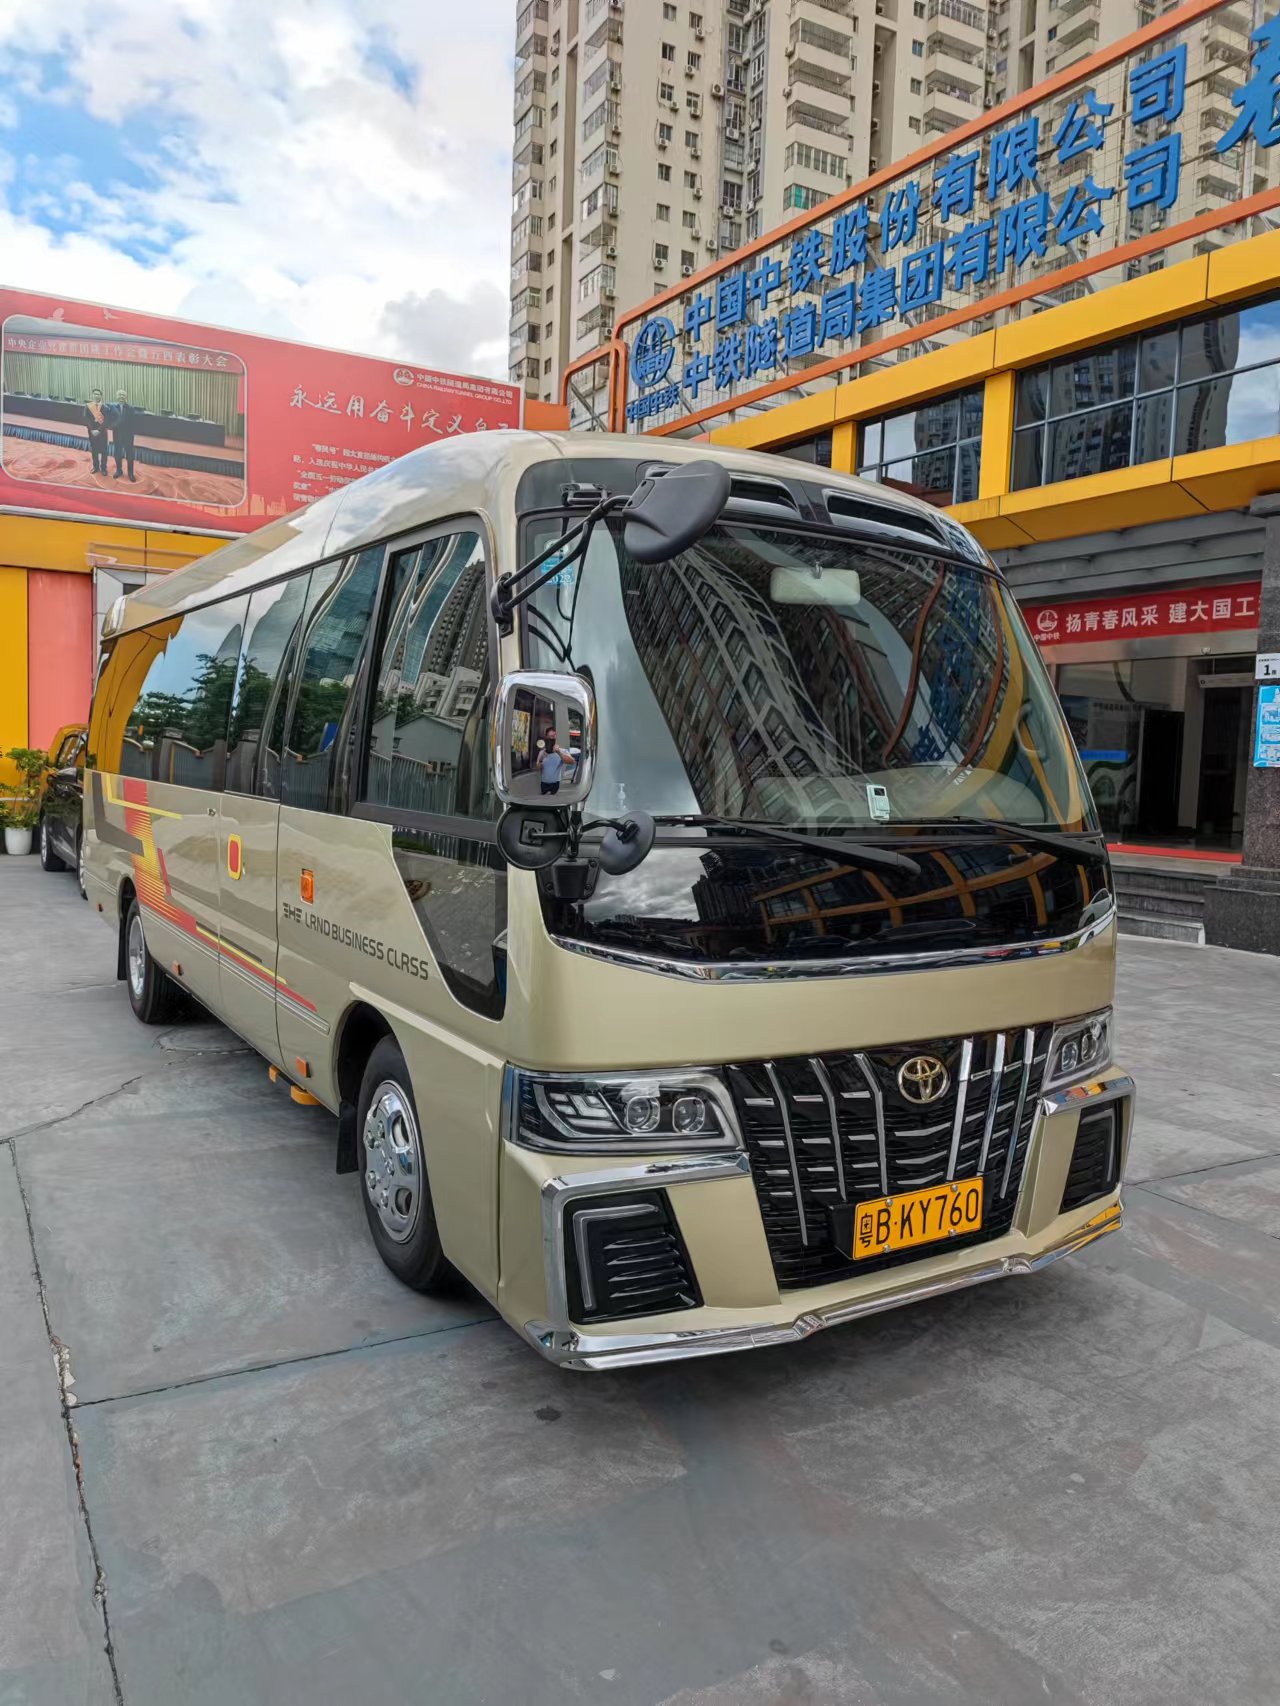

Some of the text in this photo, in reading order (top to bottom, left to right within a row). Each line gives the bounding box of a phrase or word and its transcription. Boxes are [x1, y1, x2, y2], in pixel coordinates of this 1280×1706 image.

[684, 43, 1187, 342] 中国中铁股份有限公司
[682, 131, 1183, 399] 中铁隧道局集团有限公司
[626, 384, 680, 424] 中国中铁
[1066, 597, 1261, 633] 扬青春风采 建大国工
[331, 923, 384, 960] BUSINESS
